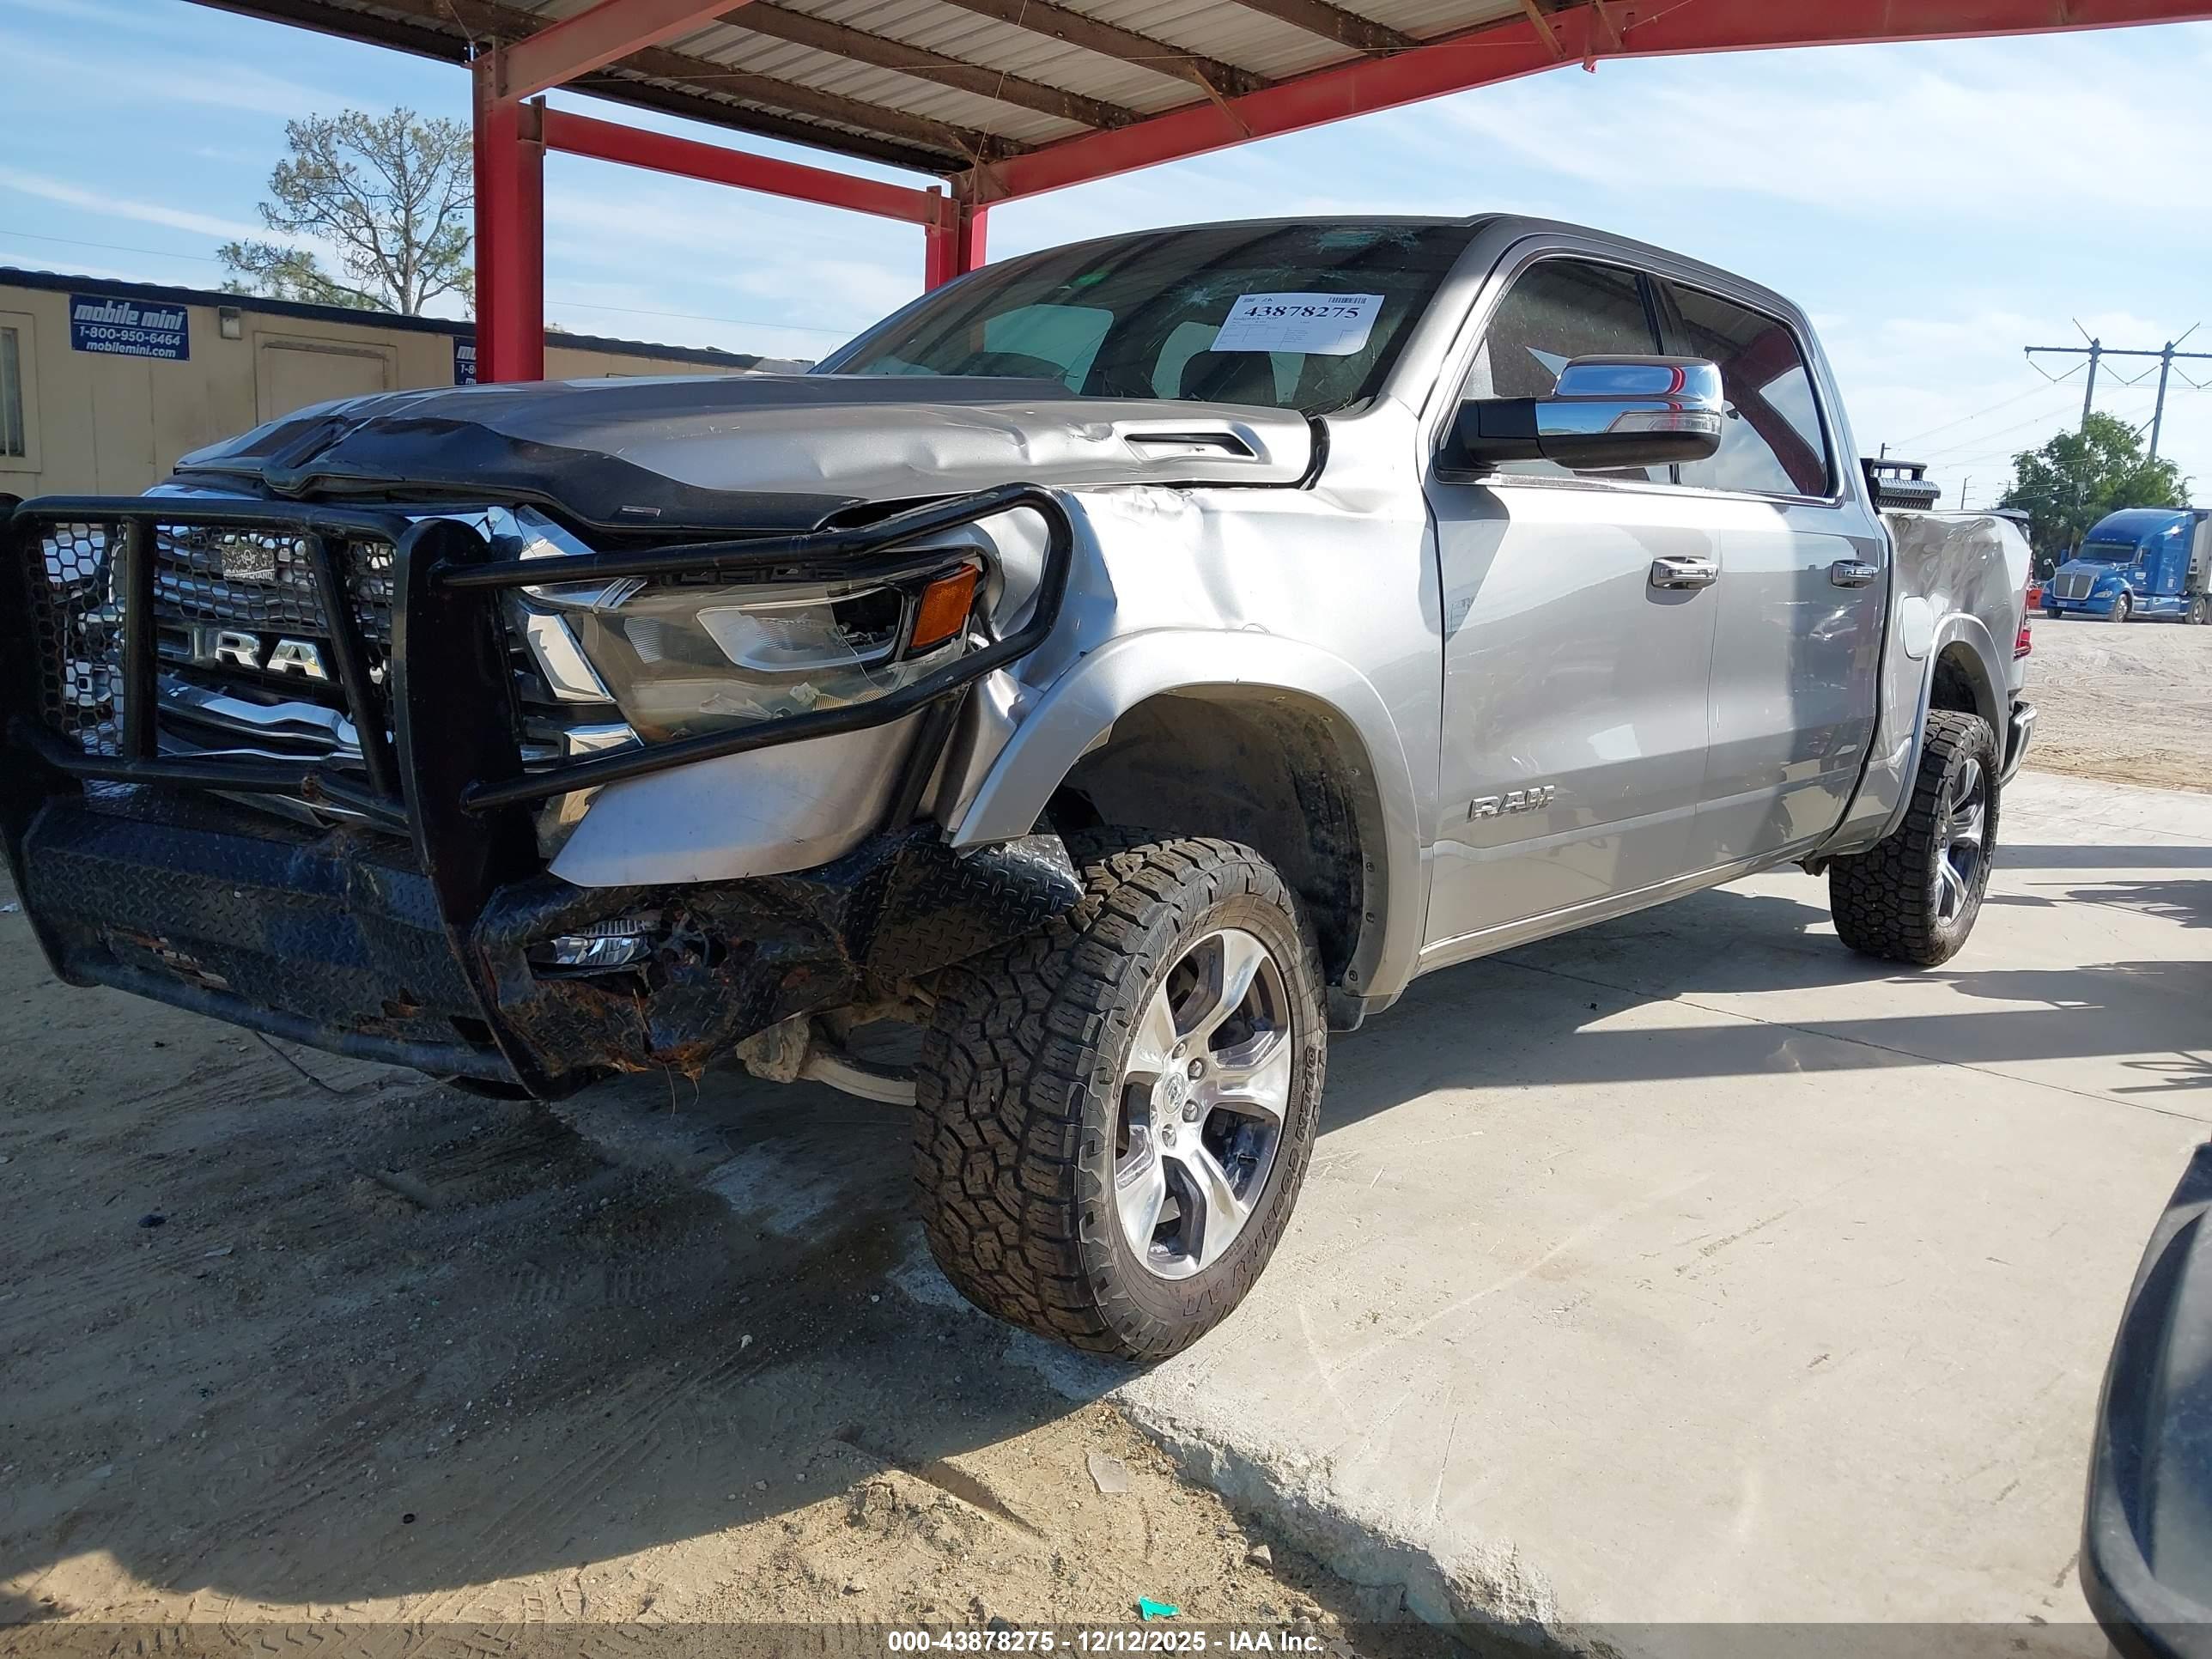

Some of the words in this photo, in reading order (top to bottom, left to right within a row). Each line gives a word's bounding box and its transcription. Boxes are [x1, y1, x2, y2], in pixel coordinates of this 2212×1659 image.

[74, 301, 139, 325] mobile
[141, 310, 186, 331] mini
[1243, 306, 1360, 319] 43878275
[79, 325, 180, 346] 1-800-950-6464
[86, 341, 177, 358] mobilemini.com
[215, 630, 330, 681] RA
[1467, 785, 1555, 821] RAM
[1295, 1044, 1318, 1142] OPEN
